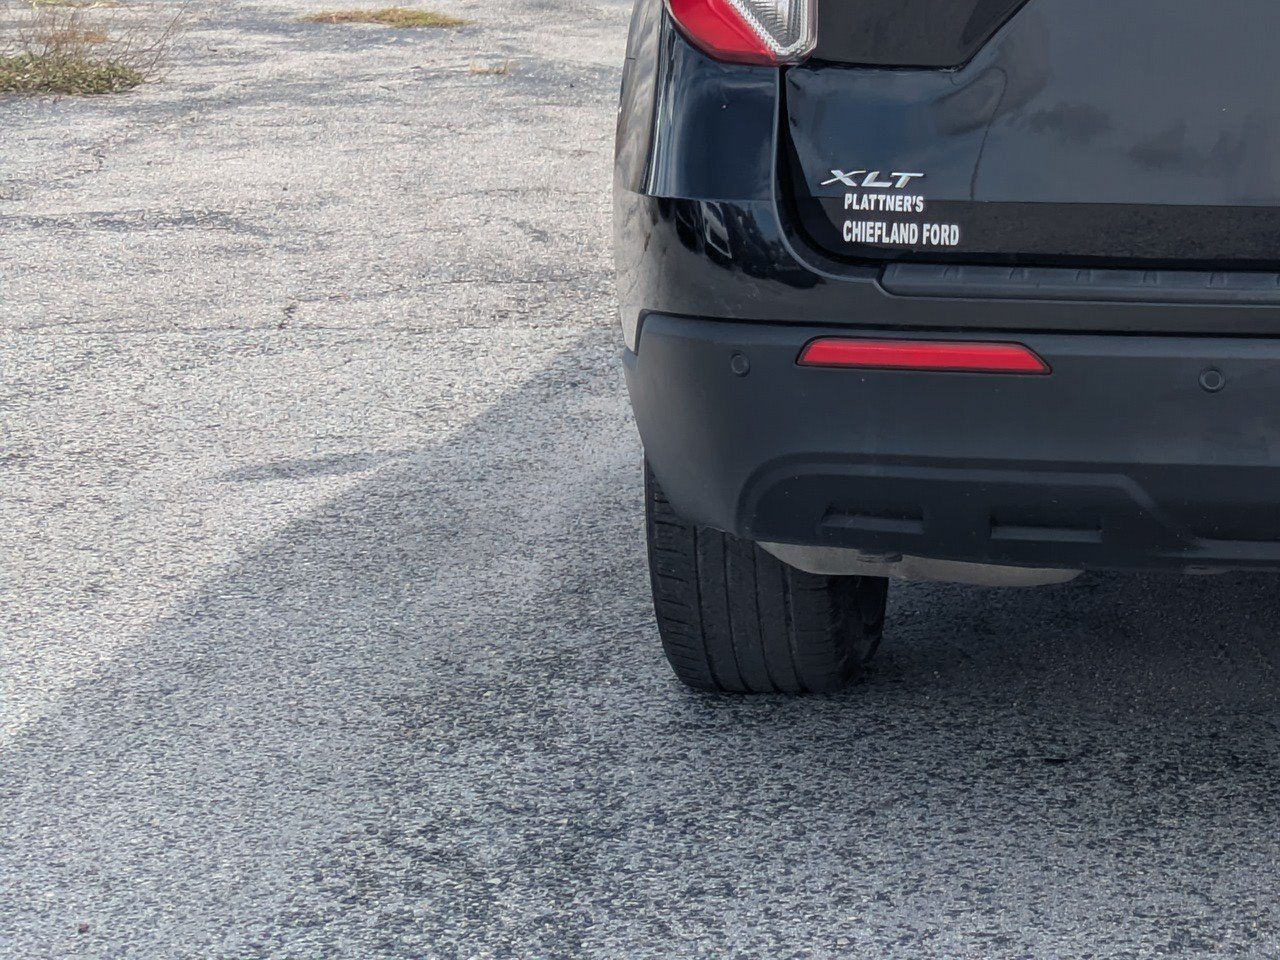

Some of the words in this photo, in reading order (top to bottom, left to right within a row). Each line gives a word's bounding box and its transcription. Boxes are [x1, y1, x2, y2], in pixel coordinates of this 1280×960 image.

[820, 169, 925, 189] XLT
[844, 193, 924, 213] PLATTNER'S
[843, 220, 919, 245] CHIEFLAND
[922, 223, 960, 246] FORD
